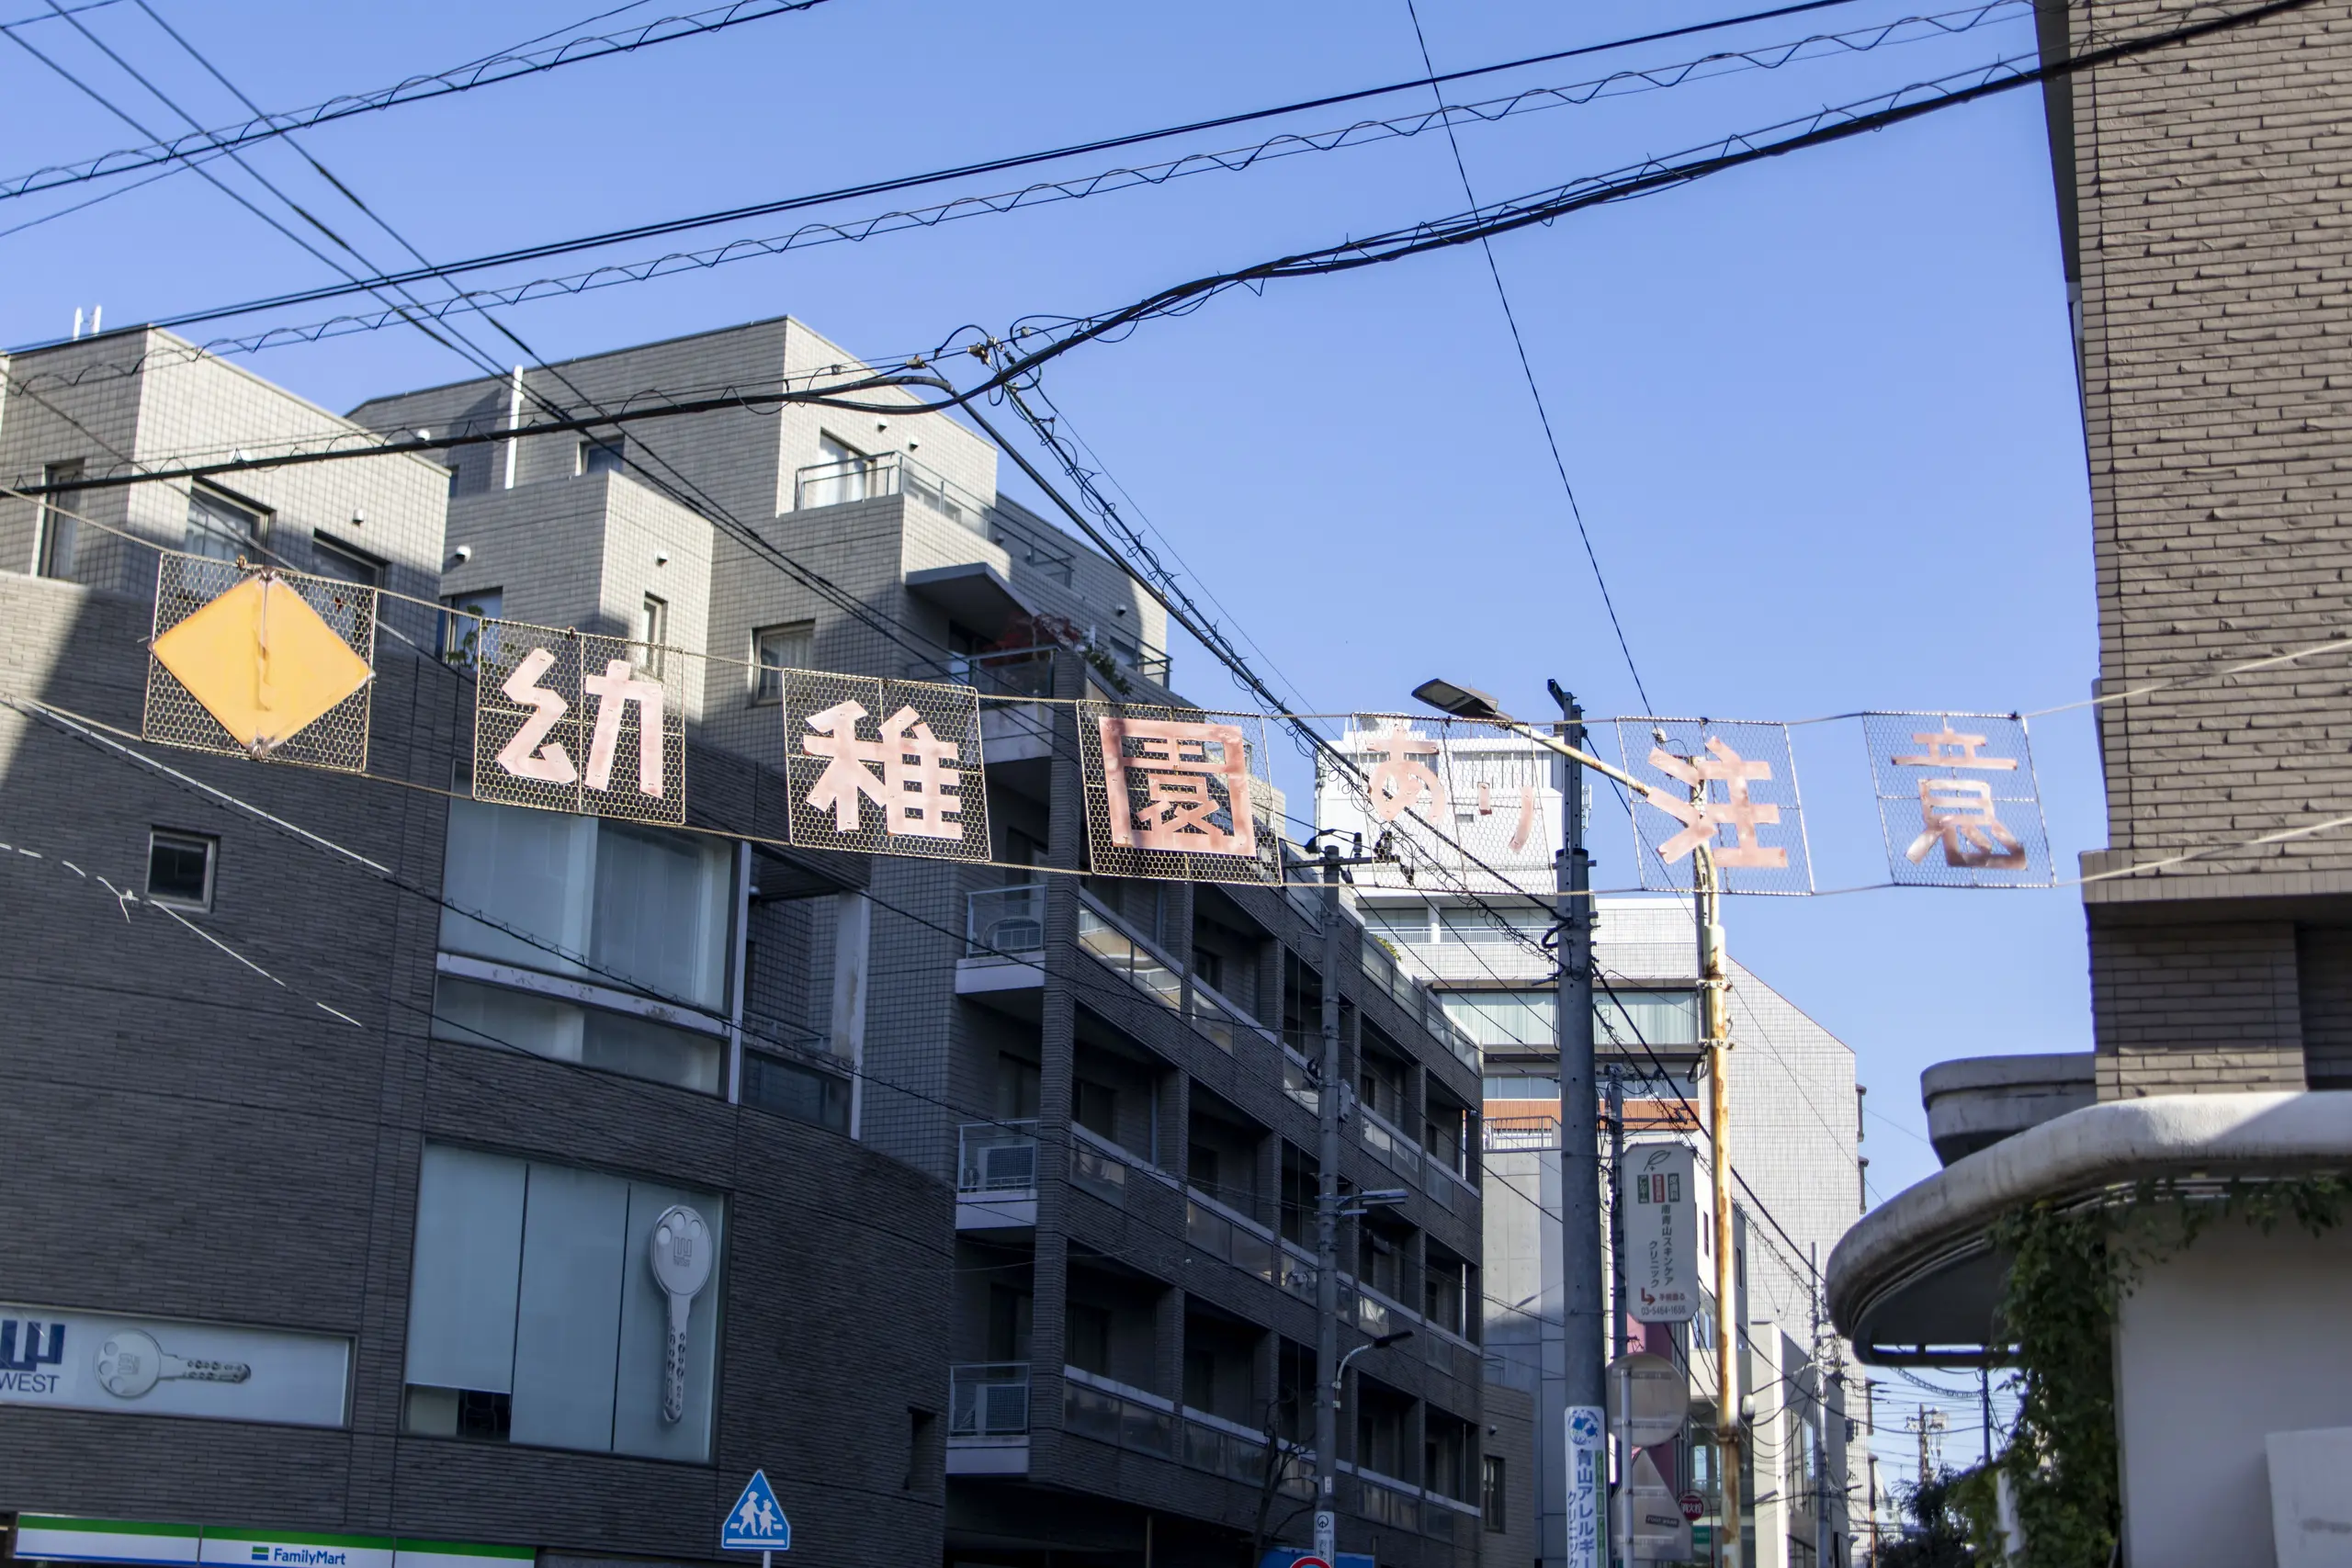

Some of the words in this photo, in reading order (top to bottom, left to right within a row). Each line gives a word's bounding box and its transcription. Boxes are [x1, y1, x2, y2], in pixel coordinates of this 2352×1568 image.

[496, 648, 2029, 871] 幼稚園あり注意
[1649, 1241, 1659, 1288] クリニック
[1661, 1204, 1674, 1286] 南青山スキンケア
[0, 1371, 61, 1393] WEST
[274, 1547, 346, 1566] FamilyMart
